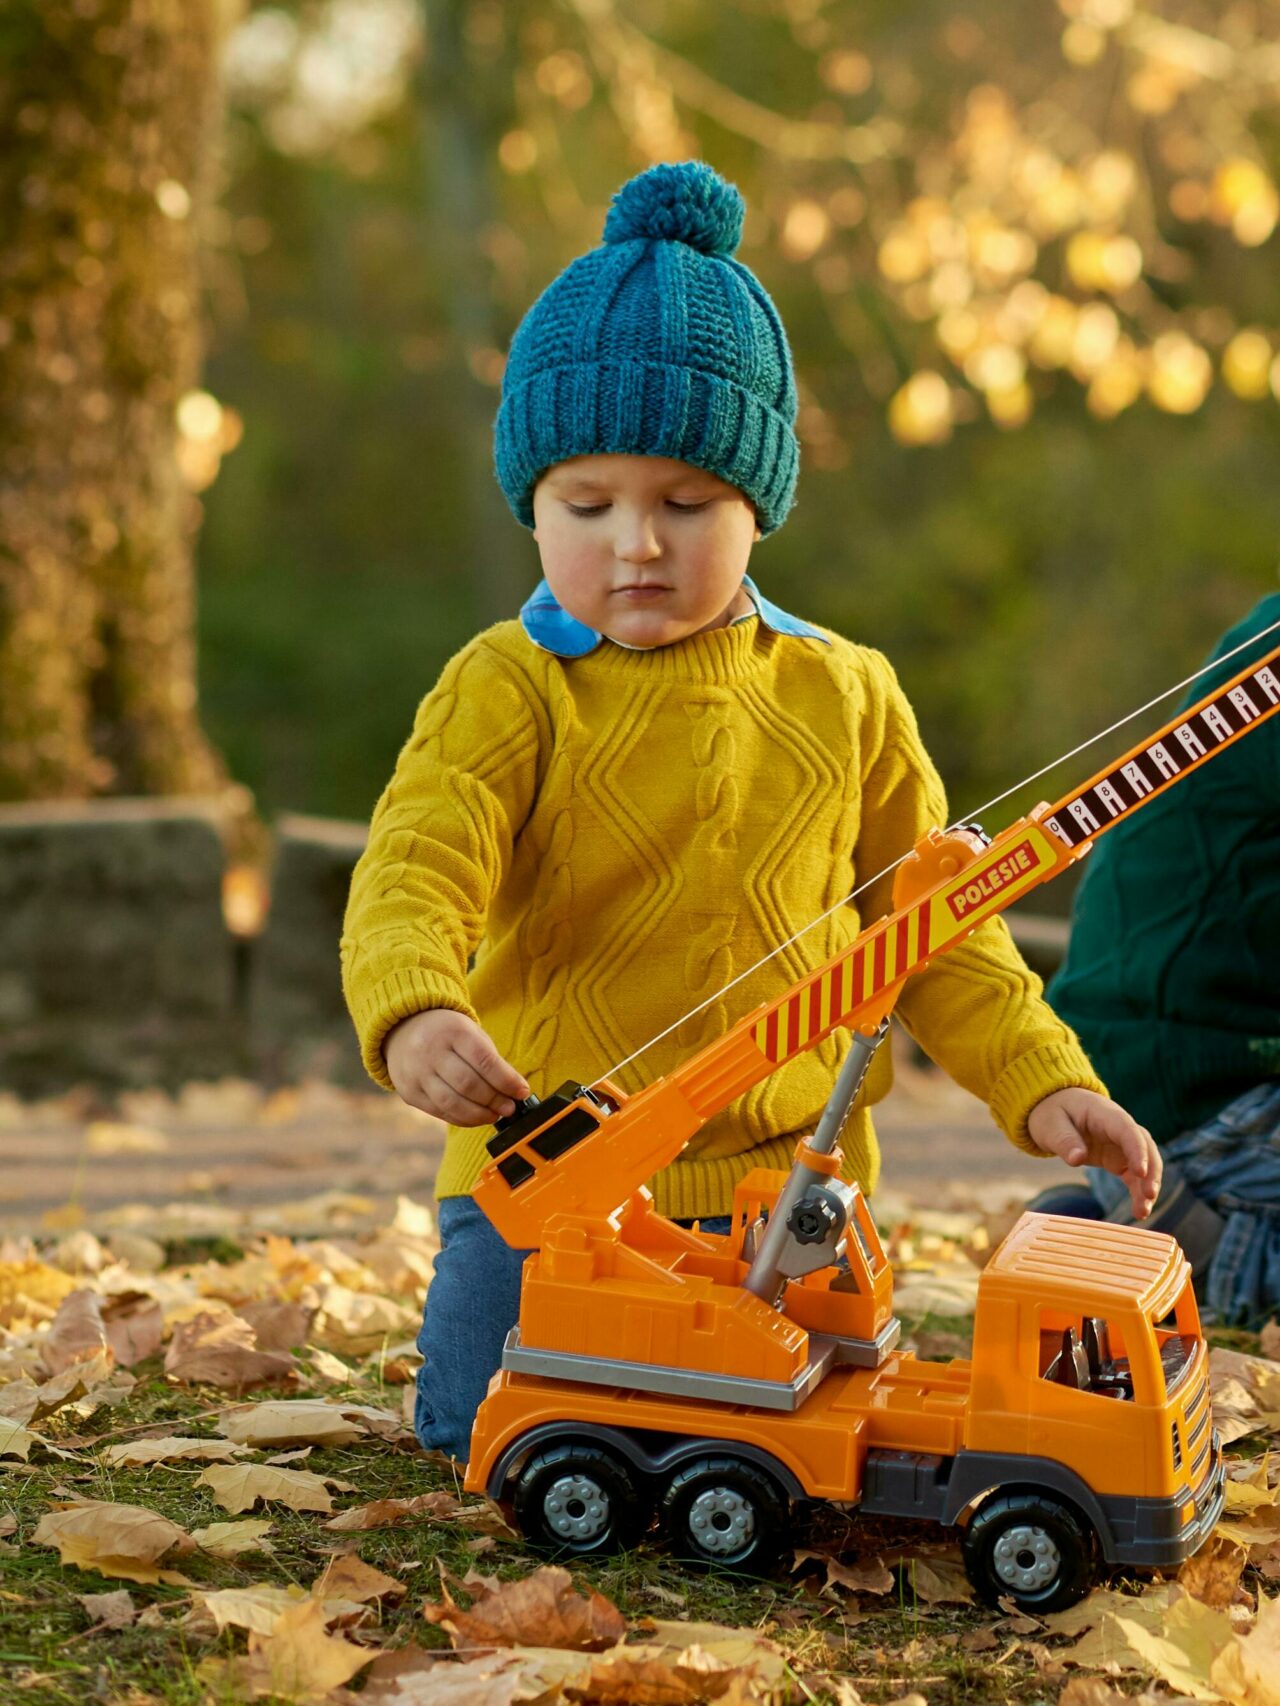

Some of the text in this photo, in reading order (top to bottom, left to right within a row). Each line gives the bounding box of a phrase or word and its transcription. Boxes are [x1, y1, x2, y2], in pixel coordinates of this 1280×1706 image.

[1261, 673, 1271, 684] 2
[1235, 692, 1244, 702] 3
[1209, 711, 1217, 721] 4
[1181, 730, 1190, 740] 5
[1155, 749, 1163, 759] 6
[1127, 767, 1135, 777] 7
[1101, 786, 1110, 797] 8
[1074, 805, 1082, 815] 9
[953, 849, 1031, 914] POLESIE
